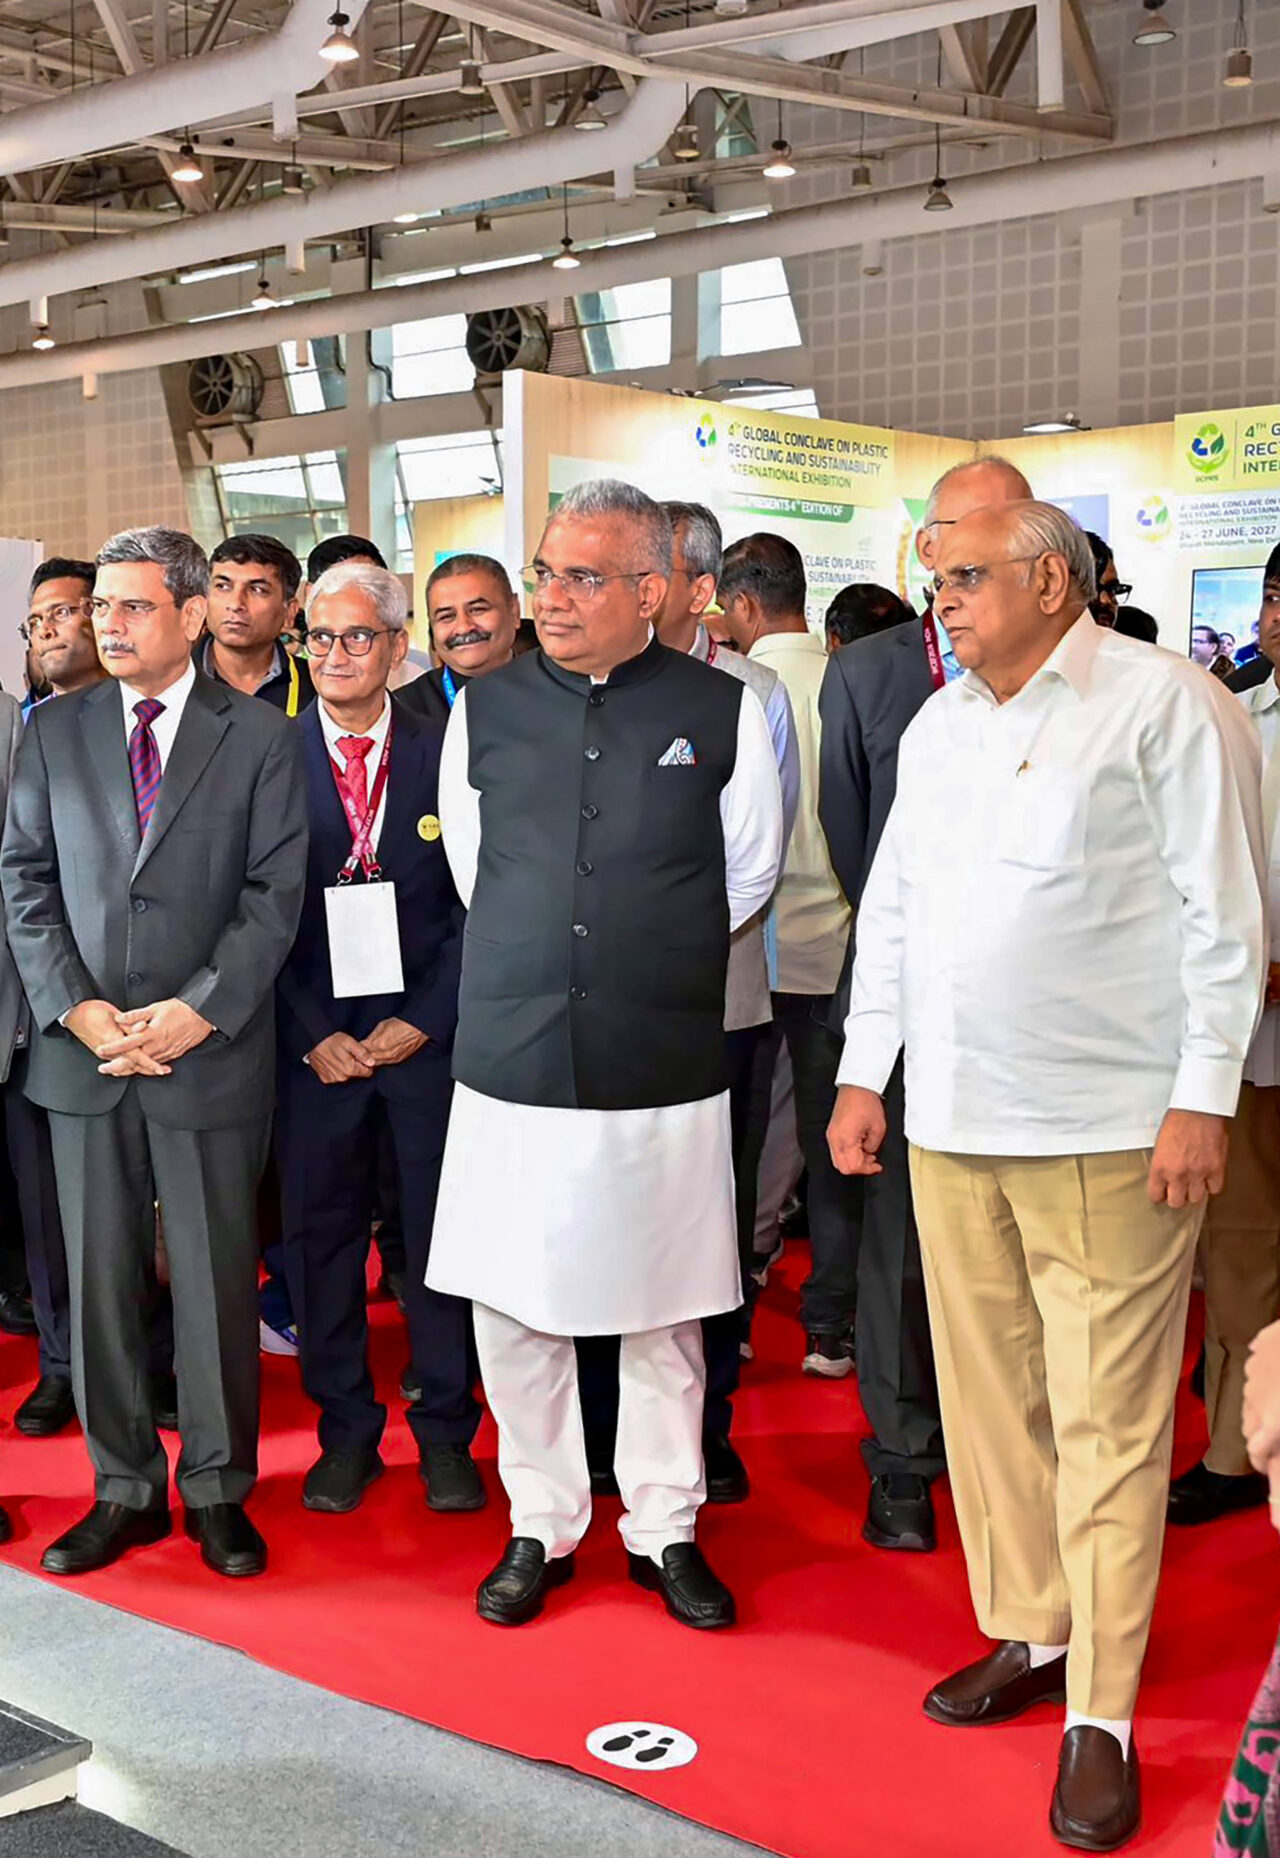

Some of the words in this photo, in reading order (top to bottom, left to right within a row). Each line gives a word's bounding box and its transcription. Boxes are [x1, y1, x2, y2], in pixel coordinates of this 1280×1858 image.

[1244, 422, 1267, 438] 4TH
[743, 426, 782, 445] GLOBAL
[784, 432, 834, 452] CONCLAVE
[836, 439, 851, 453] ON
[852, 441, 888, 459] PLASTIC
[1244, 441, 1280, 457] REC
[728, 443, 783, 463] RECYCLING
[786, 451, 807, 466] AND
[808, 454, 881, 475] SUSTAINABILITY
[1243, 459, 1280, 474] INTE
[729, 463, 800, 483] NTERNATIONAL
[802, 472, 852, 488] EXHIBITION
[1222, 499, 1263, 508] CONCLAVE
[1223, 508, 1241, 516] AND
[1201, 529, 1213, 539] 27
[1250, 525, 1277, 536] 2027
